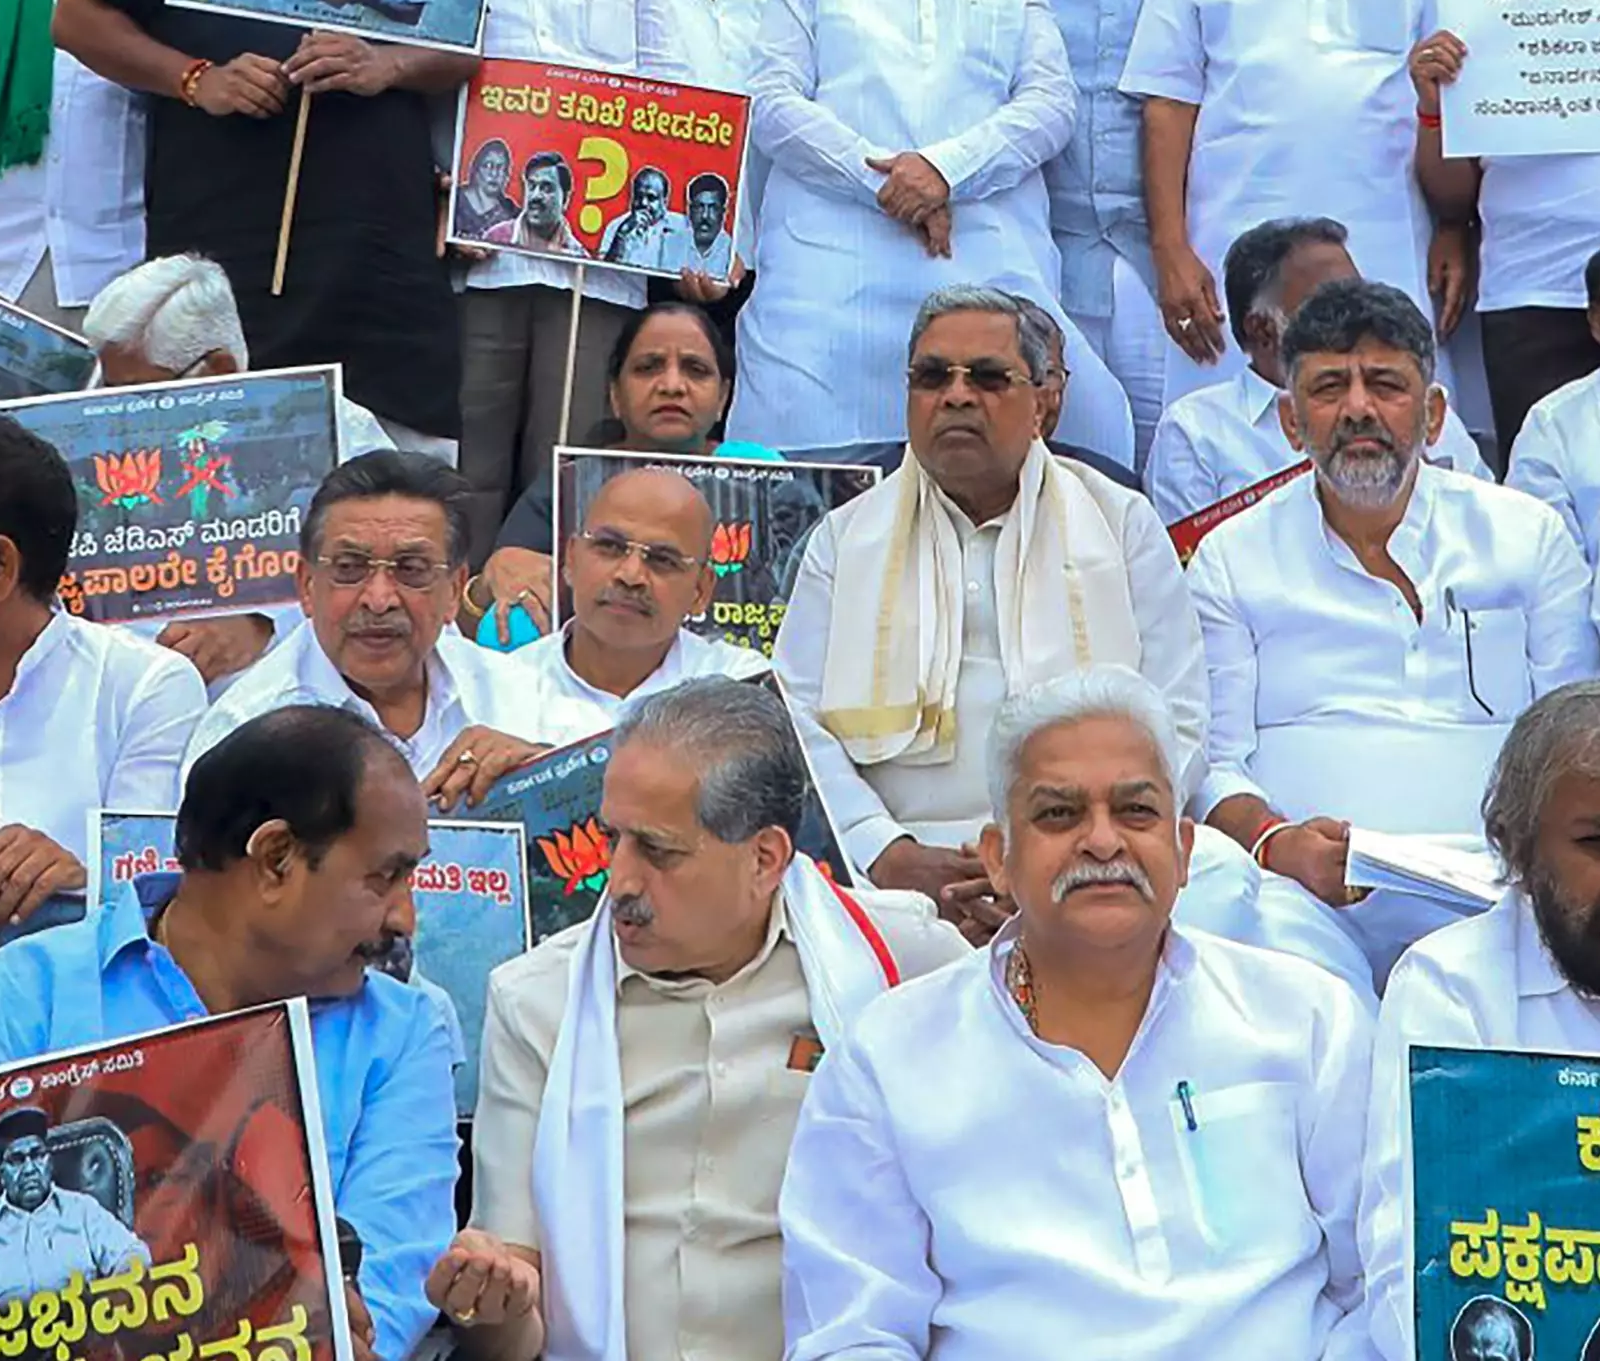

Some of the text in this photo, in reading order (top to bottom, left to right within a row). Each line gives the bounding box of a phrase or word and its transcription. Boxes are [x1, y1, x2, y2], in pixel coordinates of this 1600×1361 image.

[480, 84, 734, 145] ಇವರ ತನಿಖೆ ಬೇಡವೇ
[577, 136, 630, 235] ?
[104, 522, 195, 558] ಜೆಡಿಎಸ್
[58, 544, 301, 614] ಜ್ಯಪಾಲರೇ ಕೈಗೊಂ
[713, 601, 789, 637] ರಾಜ್ಯಪ
[403, 863, 462, 894] ಮತಿ
[467, 866, 512, 904] ಇಲ್ಲ
[39, 1059, 100, 1091] ಕಾಂಗ್ರೆಸ್
[102, 1050, 145, 1074] ಸಮಿತಿ
